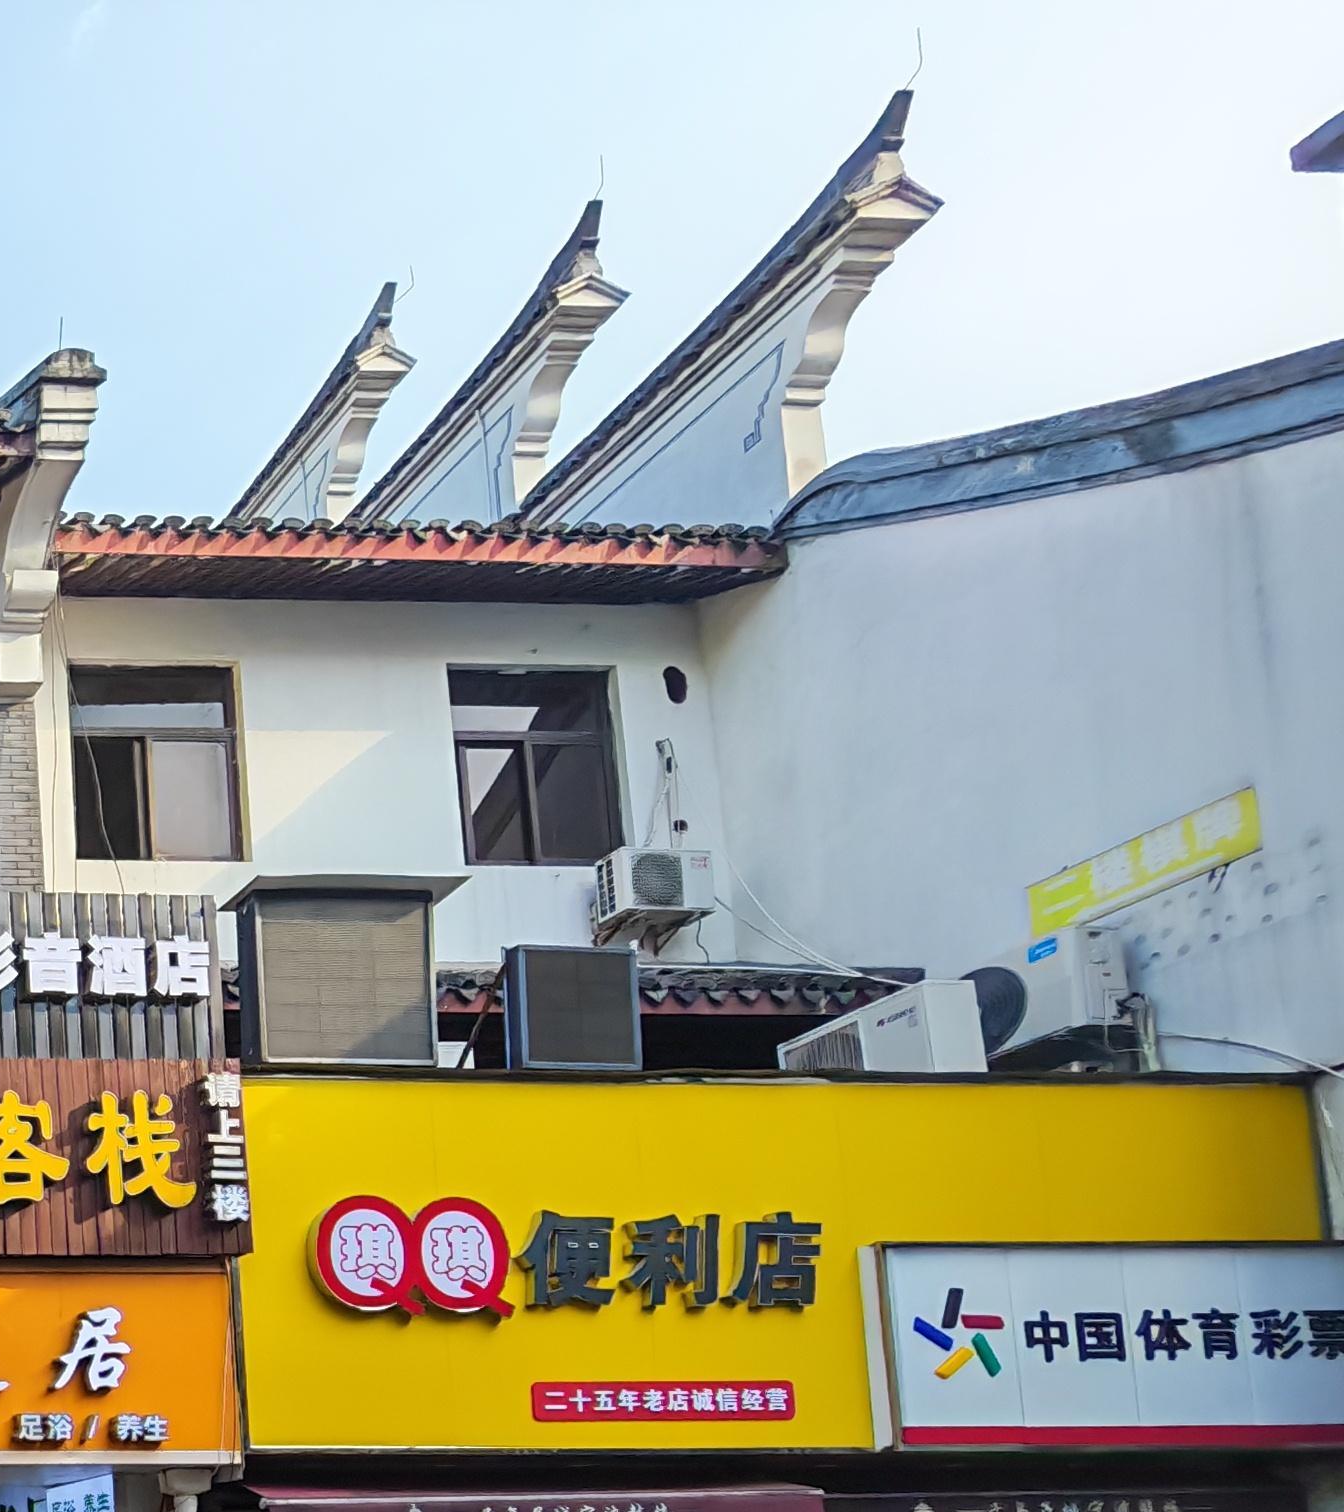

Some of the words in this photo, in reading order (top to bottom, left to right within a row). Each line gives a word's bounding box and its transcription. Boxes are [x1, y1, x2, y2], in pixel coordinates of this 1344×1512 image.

[205, 1073, 250, 1223] 请上三楼
[520, 1210, 822, 1312] 便利店
[1024, 1307, 1344, 1364] 中国体育彩票
[19, 1413, 74, 1442] 足浴
[115, 1414, 169, 1443] 养生
[544, 1387, 789, 1415] 二十五年老店诚信经营
